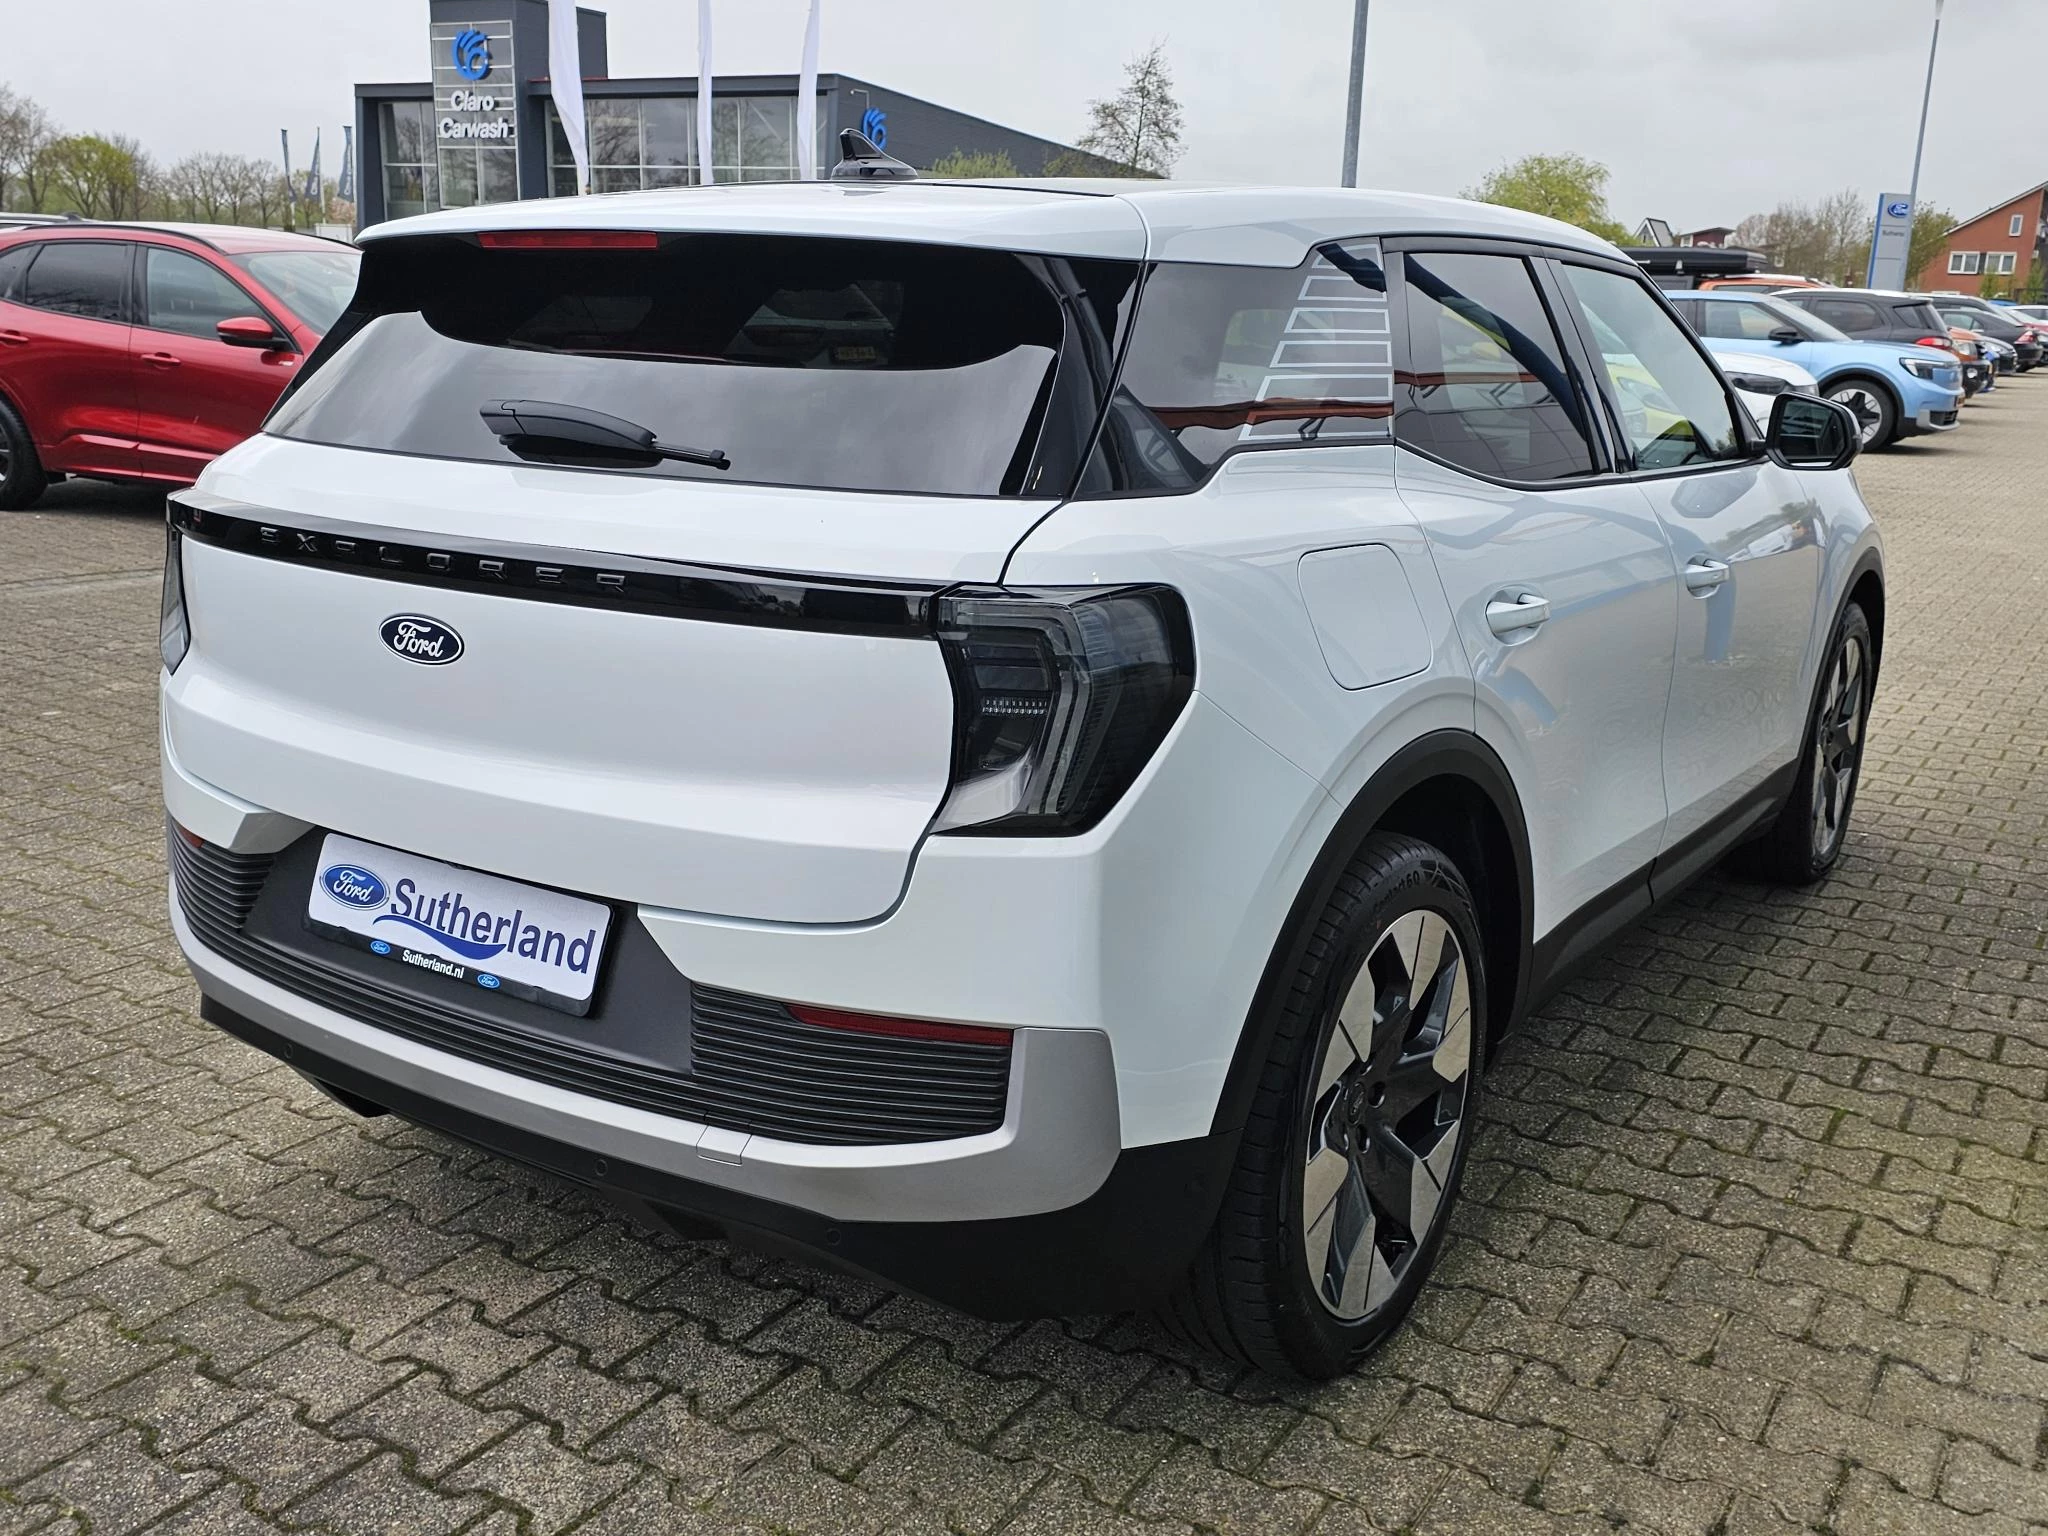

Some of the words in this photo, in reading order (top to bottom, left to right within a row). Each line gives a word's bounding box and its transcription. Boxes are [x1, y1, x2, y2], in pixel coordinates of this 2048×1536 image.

[450, 90, 495, 112] Claro
[439, 117, 510, 139] Carwash
[260, 525, 627, 593] EXPLORER
[393, 621, 445, 658] Ford
[333, 869, 374, 903] Ford
[390, 878, 597, 975] Sutherland
[402, 949, 465, 979] Sutherland.nl
